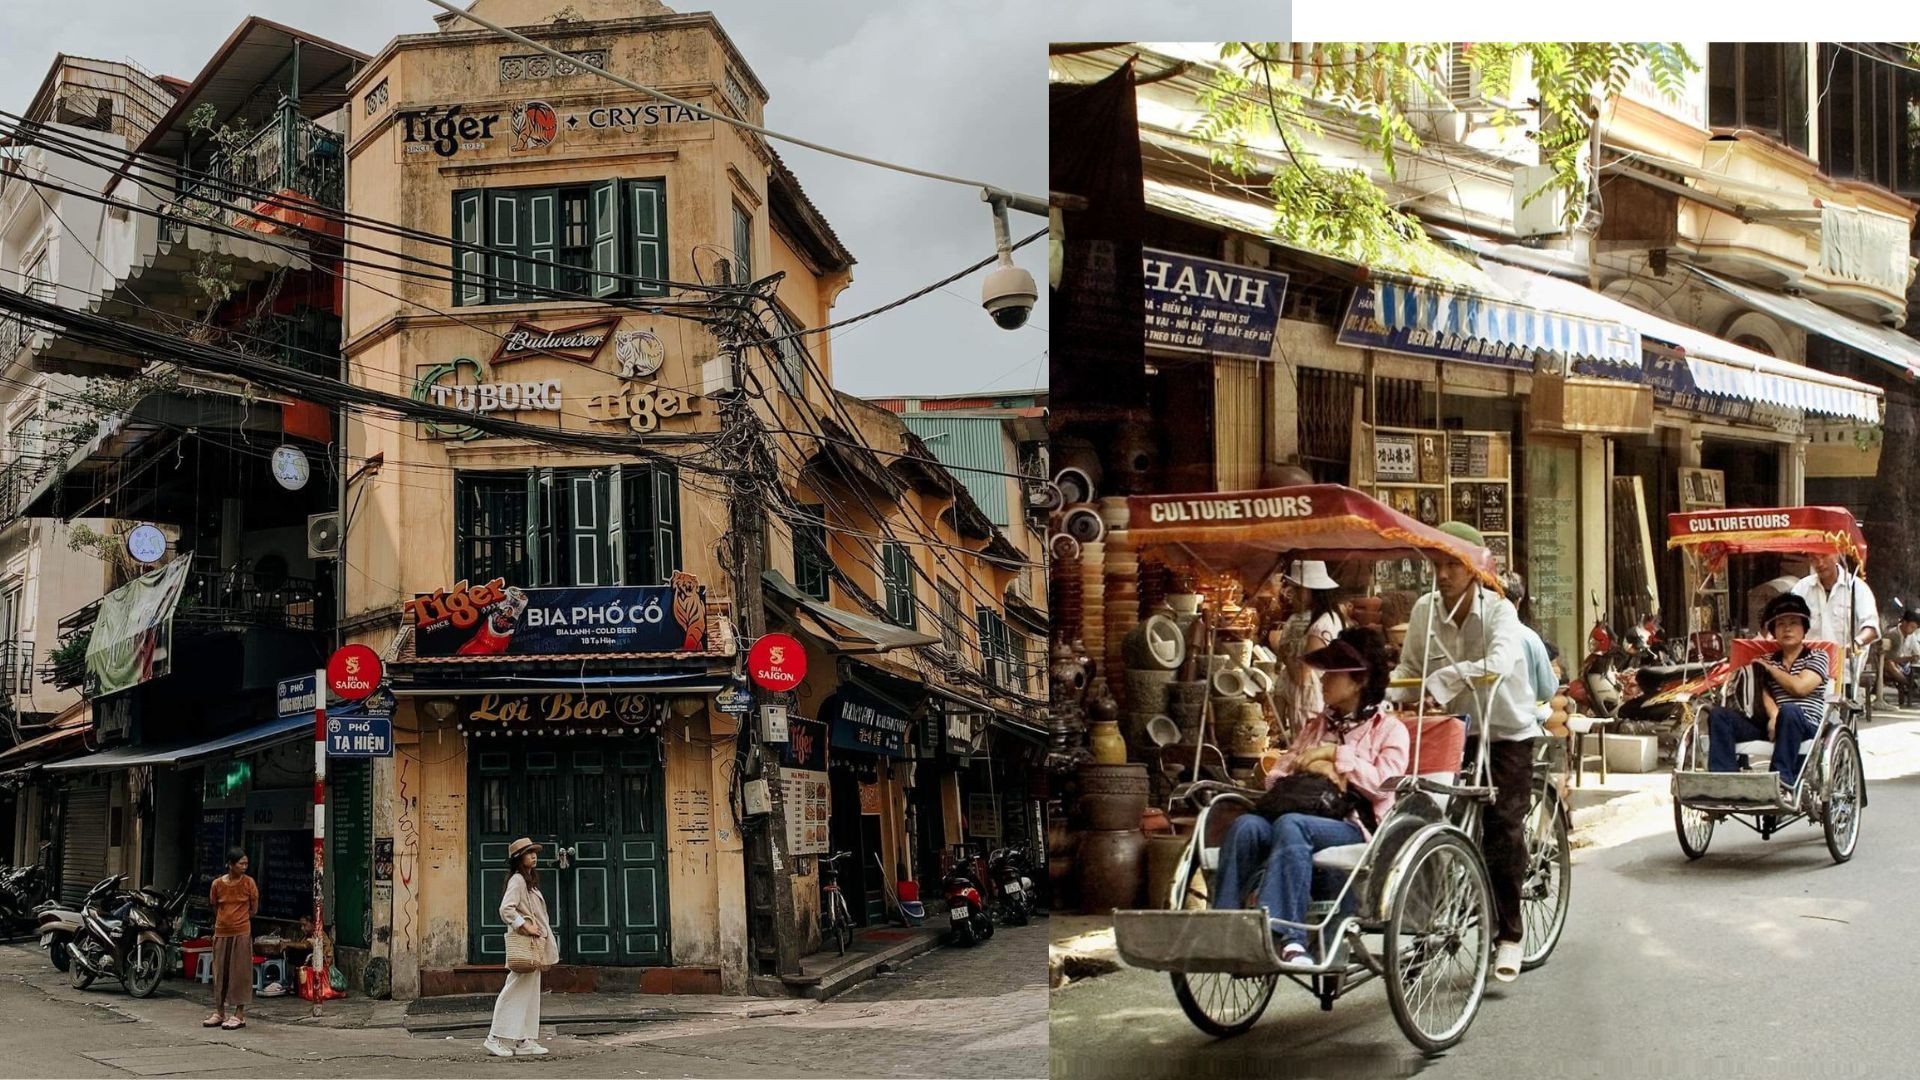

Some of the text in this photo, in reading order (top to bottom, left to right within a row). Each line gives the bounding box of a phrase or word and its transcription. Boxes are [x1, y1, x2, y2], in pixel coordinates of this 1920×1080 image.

[589, 102, 711, 130] CRYSTAL
[401, 105, 499, 157] Tiger
[502, 331, 604, 350] Budweiser
[1150, 330, 1169, 341] THEO
[431, 380, 561, 411] TUBORG
[591, 381, 700, 432] Tiger
[1151, 495, 1313, 523] CULTURETOURS
[1689, 514, 1790, 532] CULTURETOURS
[405, 577, 505, 629] Tiger
[527, 597, 663, 626] BIA PHỐ CỔ
[426, 620, 450, 633] SINCE
[290, 680, 304, 693] PHỐ
[620, 694, 646, 714] 18
[349, 720, 370, 731] PHỐ
[334, 733, 384, 752] TẠ HIỆN
[791, 724, 814, 765] Tiger
